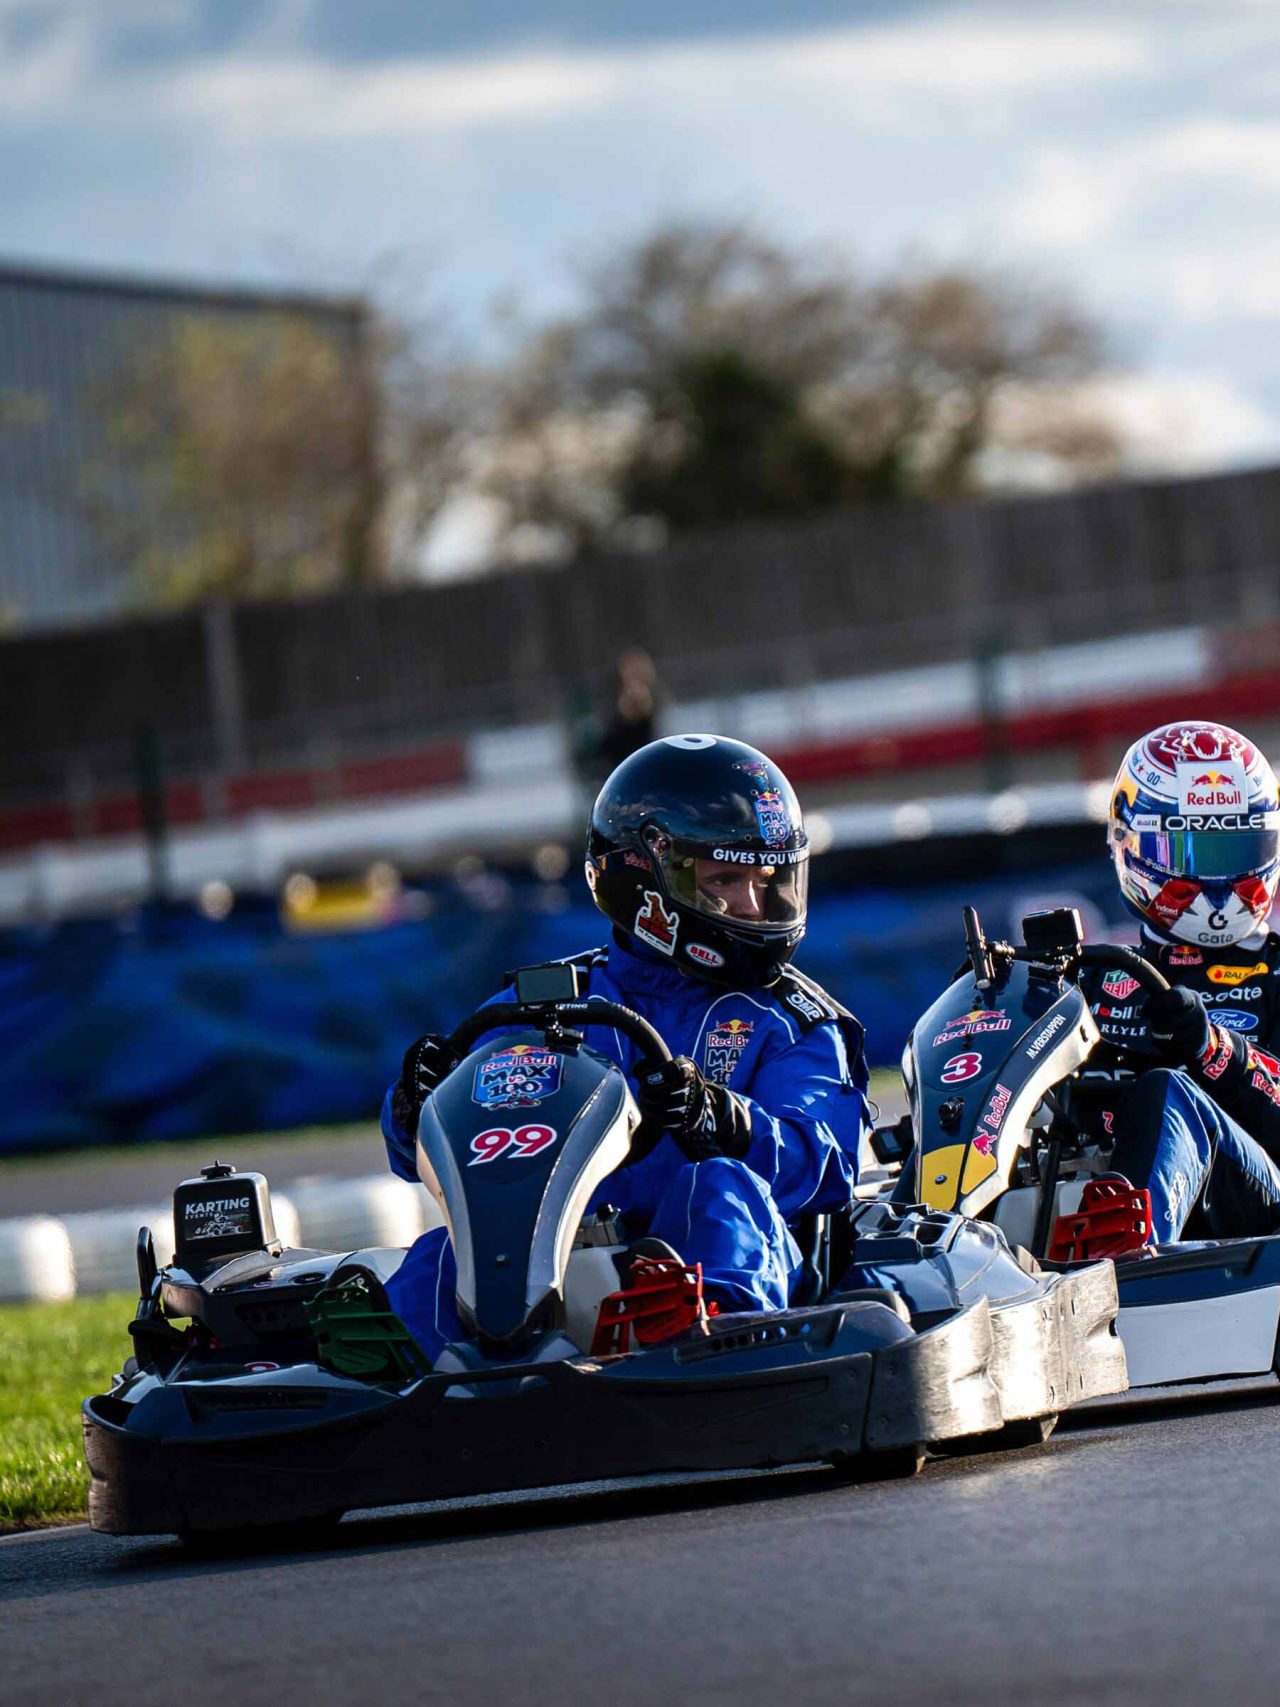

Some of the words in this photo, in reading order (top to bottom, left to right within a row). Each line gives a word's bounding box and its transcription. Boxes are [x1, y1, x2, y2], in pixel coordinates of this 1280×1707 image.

[1187, 792, 1214, 805] Red
[1216, 791, 1241, 804] Bull
[761, 810, 786, 826] MAX
[1165, 814, 1262, 830] ORACLE
[713, 848, 755, 864] GIVES
[759, 853, 785, 864] YOU
[690, 946, 719, 965] BELL
[790, 991, 822, 1019] OMP
[1211, 1011, 1248, 1028] Ford
[933, 1025, 970, 1047] Red
[972, 1018, 1012, 1035] Bull
[1100, 1023, 1147, 1036] RLYLE
[707, 1034, 733, 1048] Red
[735, 1035, 749, 1048] Bu
[483, 1054, 516, 1072] Red
[520, 1055, 557, 1066] Bull
[708, 1049, 742, 1067] MA
[1203, 1045, 1233, 1080] Red
[482, 1066, 552, 1085] MAX
[940, 1052, 983, 1083] 3
[488, 1080, 543, 1098] 100
[992, 1083, 1013, 1111] Bull
[984, 1102, 1004, 1129] Red
[467, 1124, 557, 1166] 99
[185, 1197, 249, 1215] KARTING
